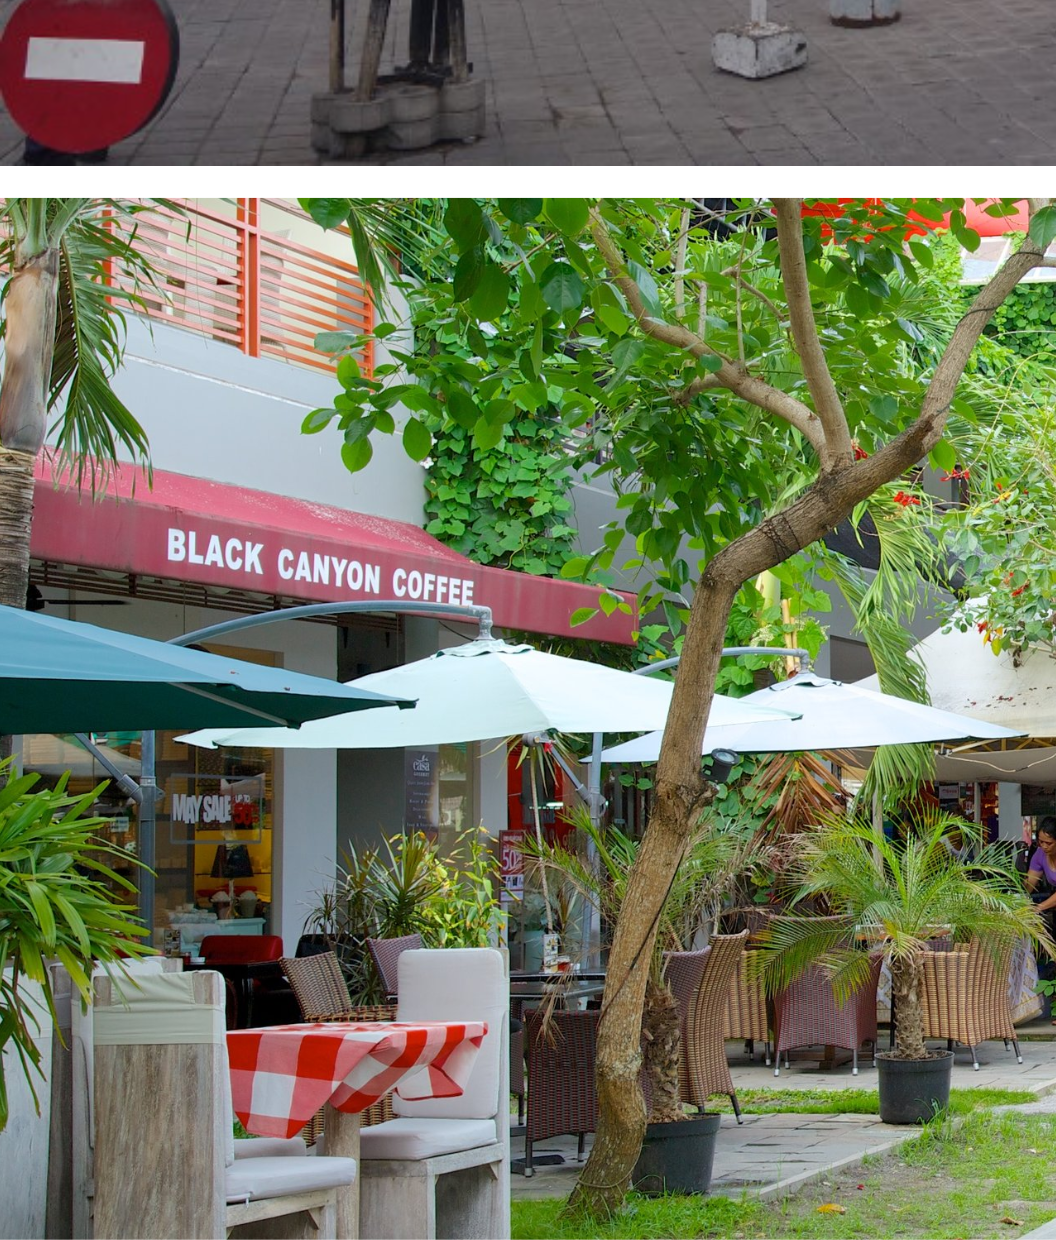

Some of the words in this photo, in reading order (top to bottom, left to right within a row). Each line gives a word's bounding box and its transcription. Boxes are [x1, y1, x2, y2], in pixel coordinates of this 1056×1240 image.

[167, 527, 264, 575] BLACK
[277, 548, 380, 594] CANYON
[392, 567, 474, 607] COFFEE
[172, 793, 203, 824] MAY
[203, 794, 232, 823] SALE
